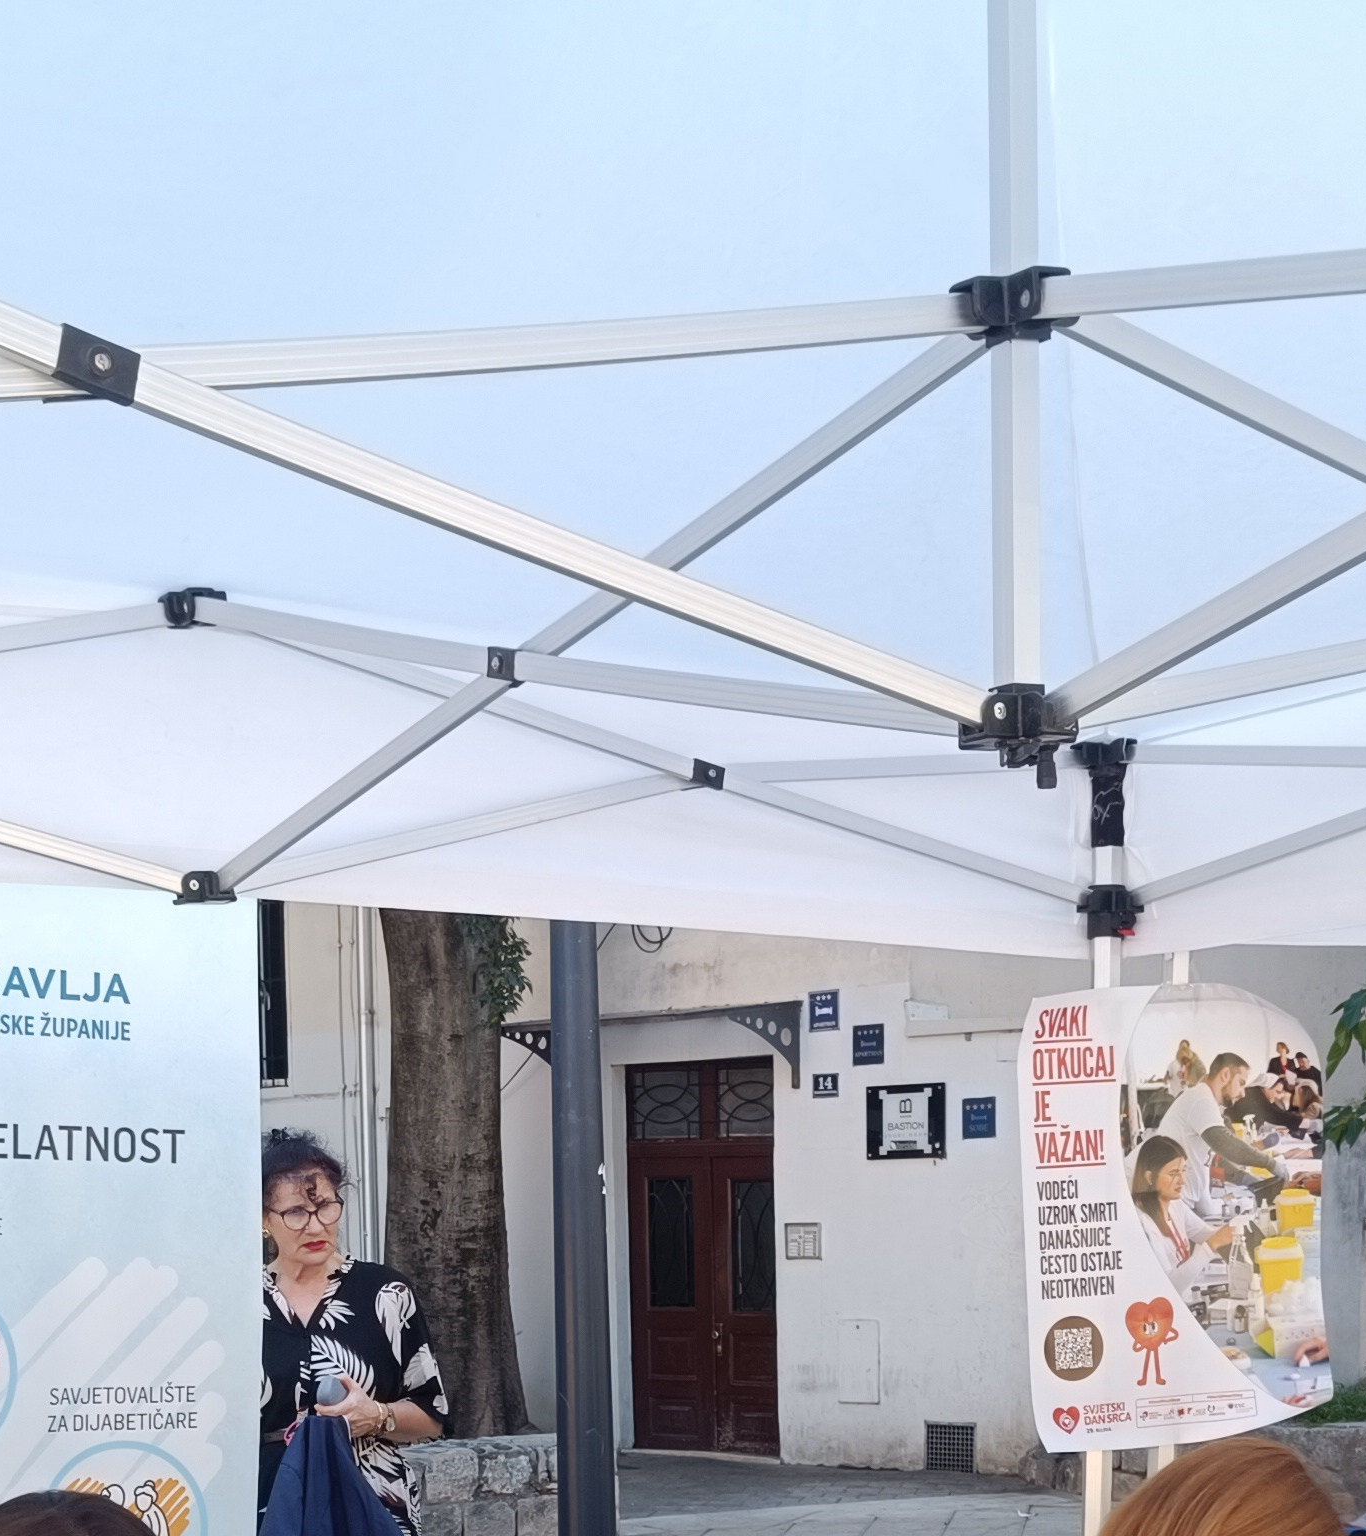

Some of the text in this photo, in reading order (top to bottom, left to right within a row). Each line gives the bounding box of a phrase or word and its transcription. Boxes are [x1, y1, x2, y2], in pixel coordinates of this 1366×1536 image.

[39, 1012, 131, 1042] ŽUPANIJE
[1035, 1005, 1088, 1038] SVAKI
[1033, 1046, 1116, 1079] OTKUCAJ
[818, 1076, 833, 1090] 14
[1034, 1090, 1051, 1122] JE
[887, 1122, 925, 1132] BASTION
[1035, 1125, 1105, 1163] VAŽAN!
[1037, 1178, 1079, 1201] VODEĆI
[1038, 1202, 1118, 1226] UZROK SMRTI
[1039, 1224, 1111, 1250] DANAŠNJICE
[1040, 1251, 1123, 1275] ČESTO OSTAJE
[1041, 1277, 1115, 1300] NEOTKRIVEN
[48, 1381, 197, 1407] SAVJETOVALIŠTE
[46, 1407, 198, 1433] ZA DIJABETIČARE
[1083, 1402, 1125, 1414] SVJETSKI
[1084, 1414, 1106, 1425] DAN
[1107, 1413, 1132, 1423] SRCA
